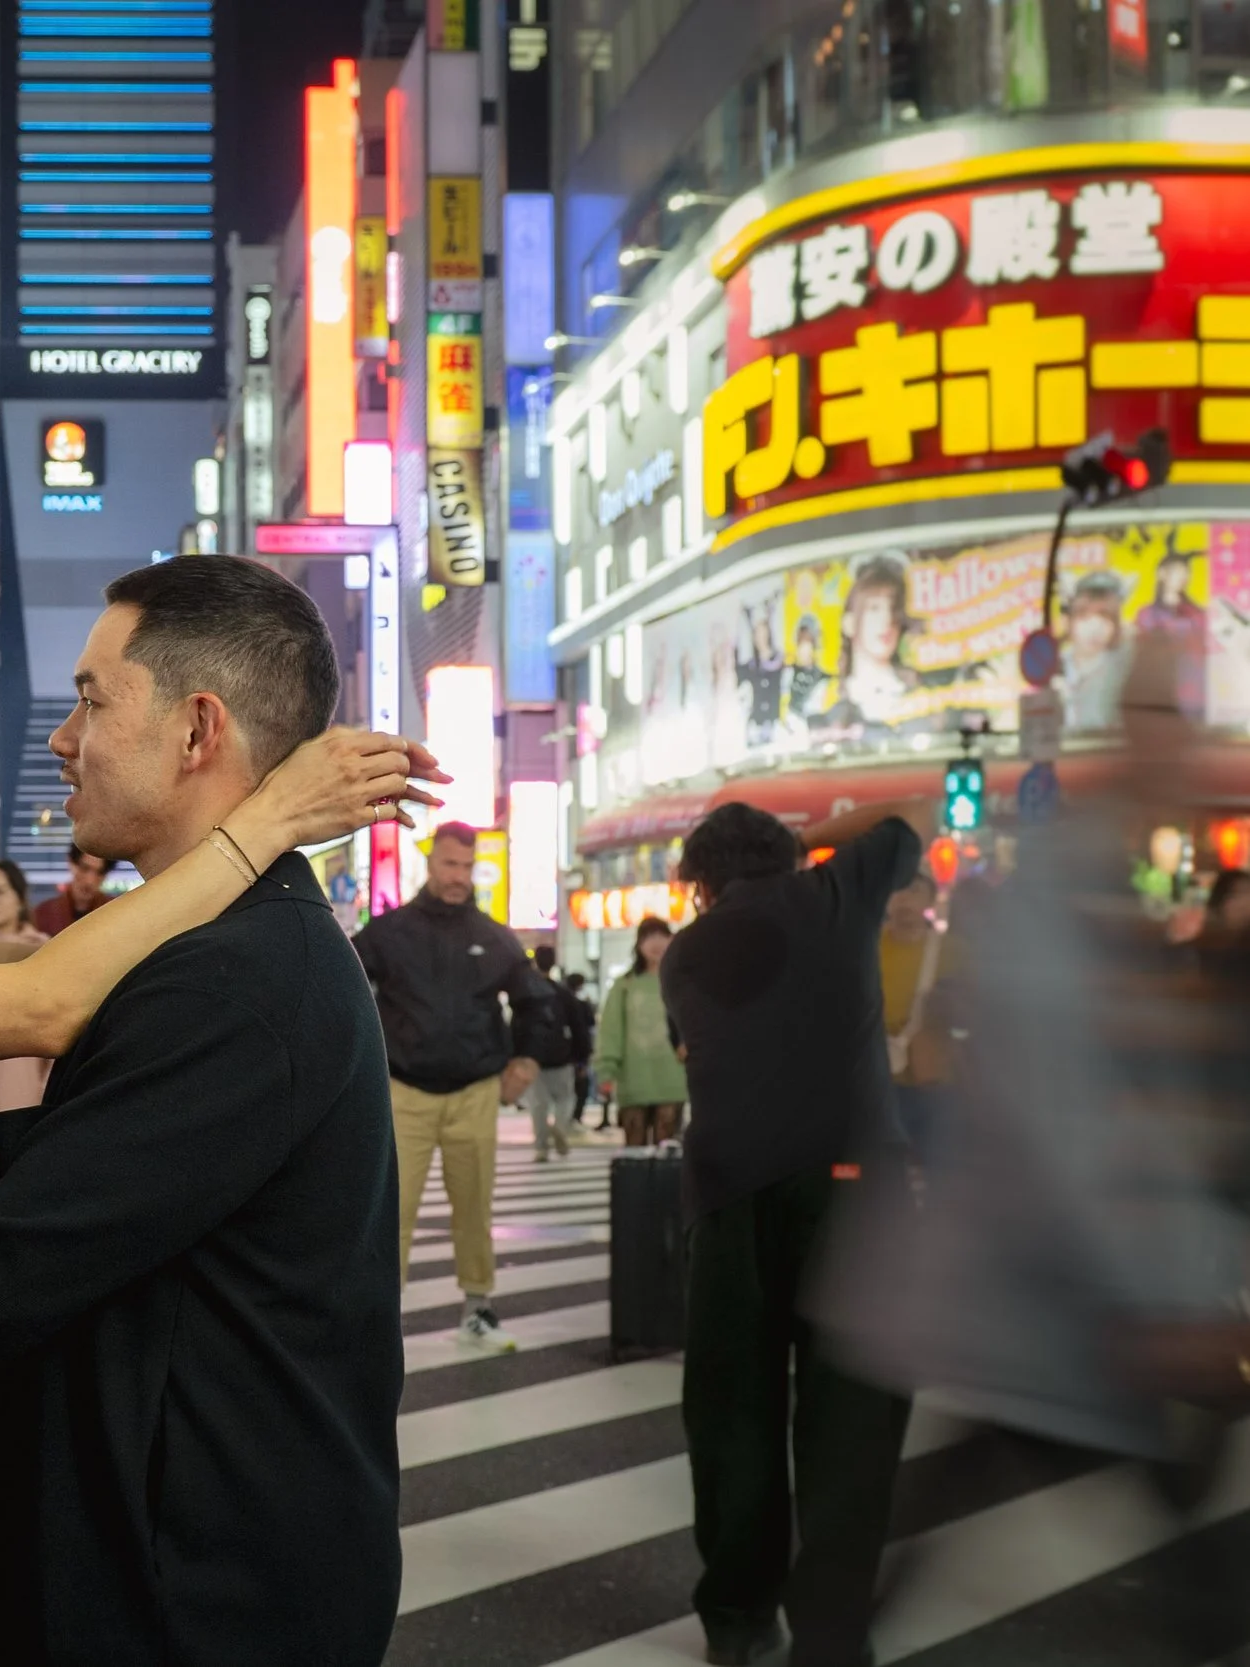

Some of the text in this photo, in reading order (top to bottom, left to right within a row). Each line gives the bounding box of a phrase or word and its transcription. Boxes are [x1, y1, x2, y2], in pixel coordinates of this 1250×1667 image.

[29, 349, 203, 375] HOTEL GRACERY
[438, 343, 475, 413] 麻雀
[42, 494, 104, 513] IMAX
[431, 458, 480, 576] CASINO
[910, 541, 1107, 613] Halloween
